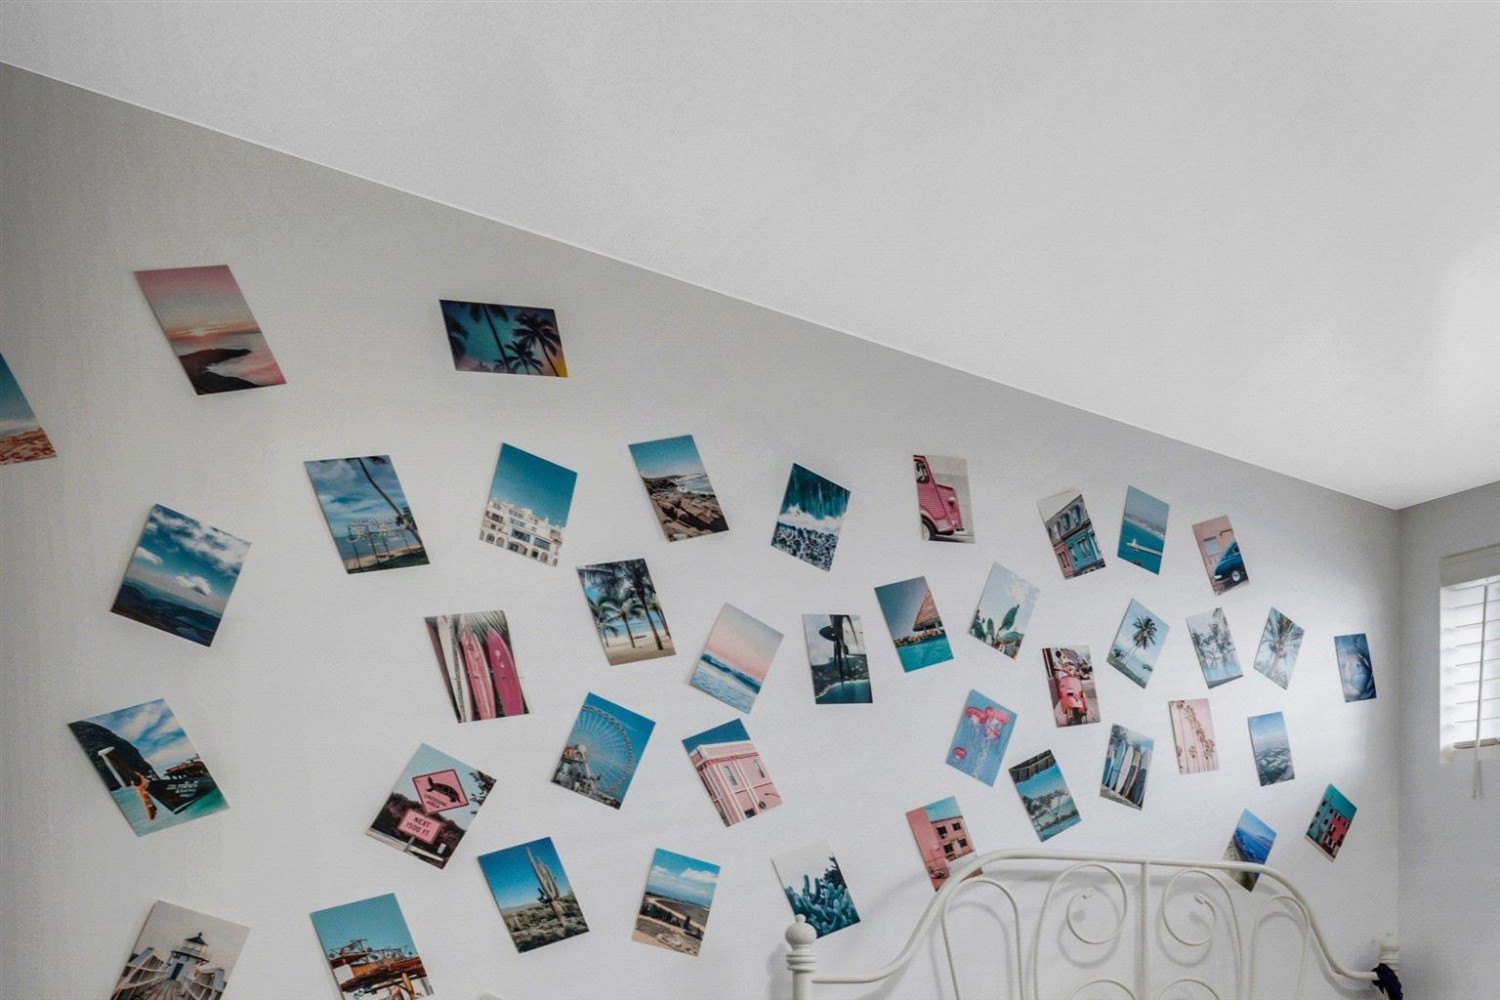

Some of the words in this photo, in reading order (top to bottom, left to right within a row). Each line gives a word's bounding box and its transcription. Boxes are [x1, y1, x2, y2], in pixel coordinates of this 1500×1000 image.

[414, 816, 431, 828] NEXT
[405, 822, 421, 834] 1500
[421, 828, 431, 836] FT
